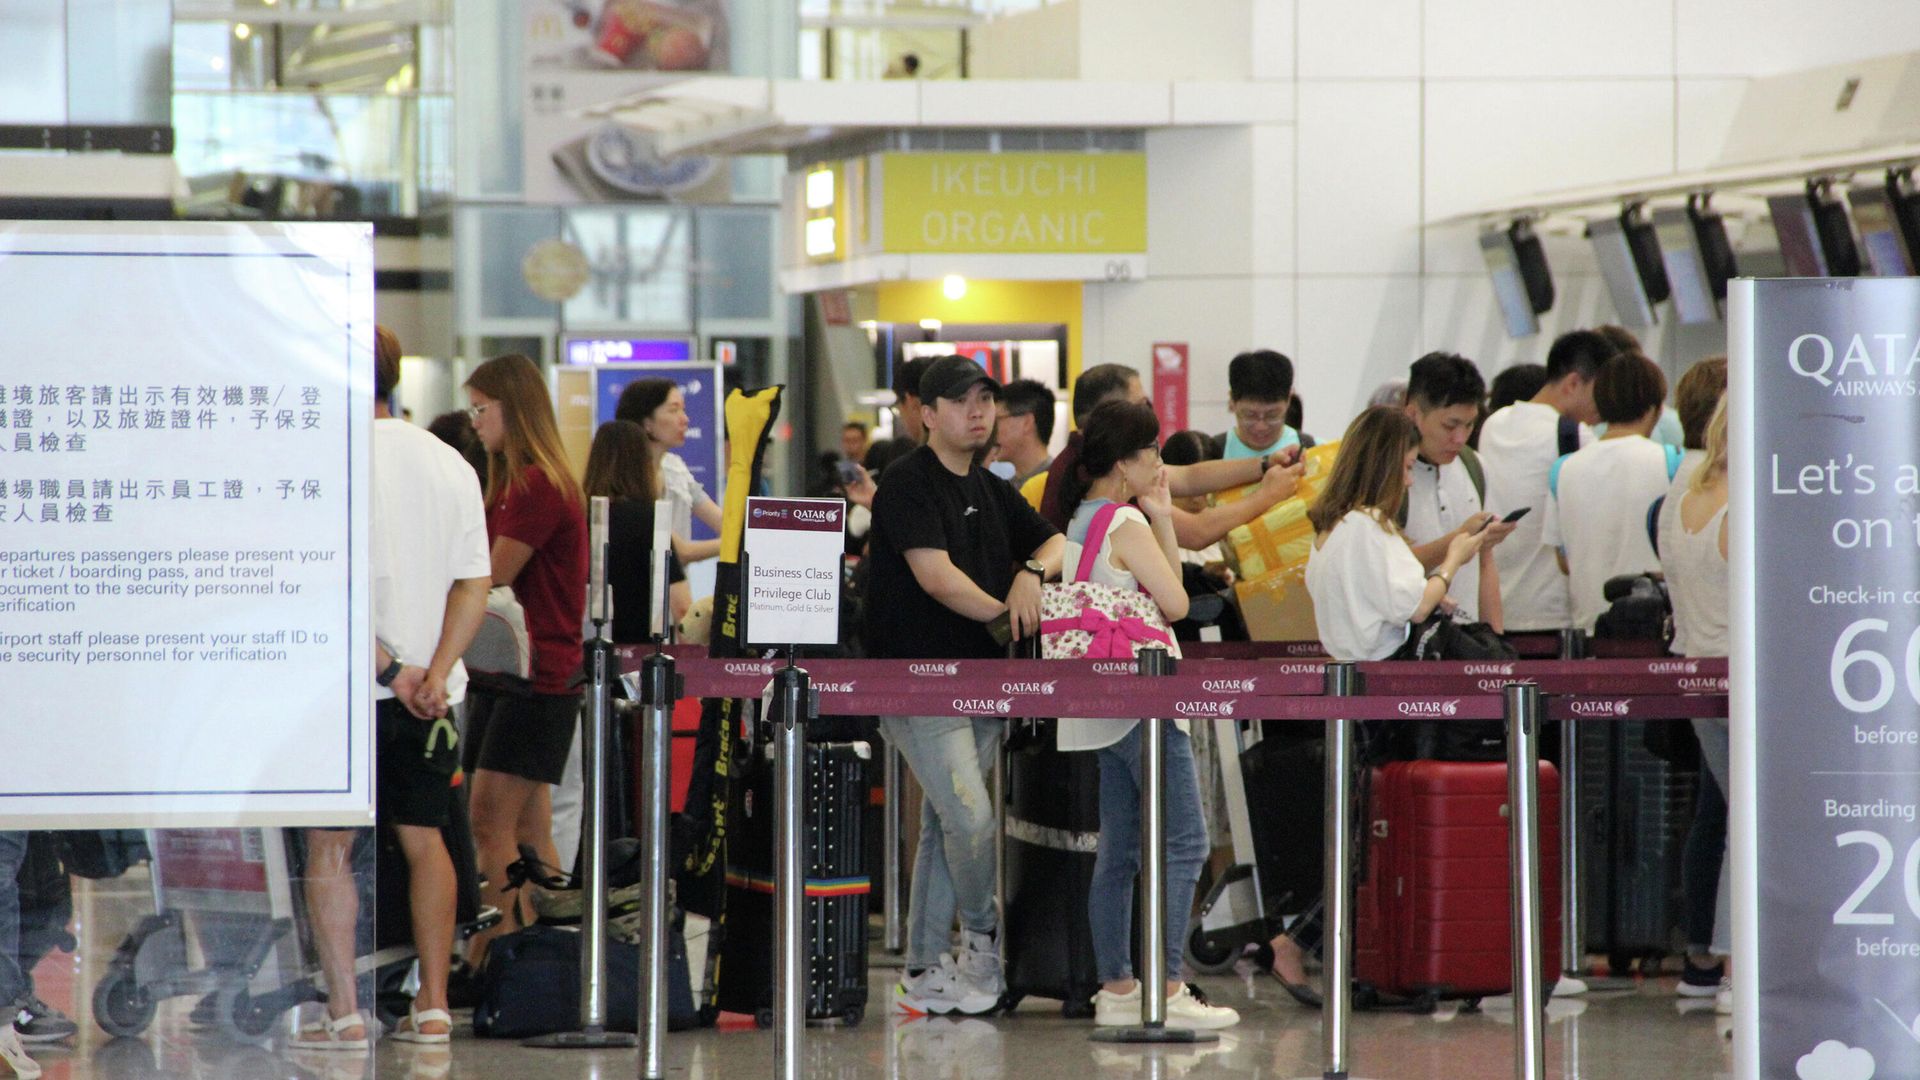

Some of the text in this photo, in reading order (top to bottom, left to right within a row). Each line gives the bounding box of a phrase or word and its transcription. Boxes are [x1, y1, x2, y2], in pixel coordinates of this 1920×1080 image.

[931, 161, 1097, 197] IKEUCHI
[922, 209, 1105, 246] ORGANIC
[1833, 380, 1915, 397] AIRWAYS
[1772, 453, 1876, 495] Let's
[793, 509, 825, 520] QATAR
[1832, 517, 1892, 549] on
[81, 549, 172, 565] passengers
[178, 548, 229, 564] please
[235, 549, 294, 565] present
[300, 550, 336, 564] your
[13, 564, 54, 578] ticket
[59, 565, 65, 578] /
[70, 564, 142, 582] boarding
[148, 566, 189, 582] pass,
[194, 564, 224, 578] and
[230, 564, 274, 578] travel
[754, 566, 833, 580] Business Class
[75, 583, 90, 595] to
[96, 581, 121, 595] the
[127, 581, 189, 599] security
[194, 581, 274, 599] personnel
[280, 581, 302, 595] for
[754, 587, 832, 602] Privilege Club
[1809, 585, 1895, 604] Check-in
[749, 602, 833, 613] Platinum, Gold & Silver
[48, 630, 83, 646] staff
[88, 631, 139, 648] please
[145, 633, 204, 649] present
[210, 633, 245, 649] your
[251, 630, 285, 645] staff
[291, 630, 308, 644] ID
[313, 631, 329, 645] to
[18, 646, 80, 664] security
[86, 646, 166, 664] personnel
[172, 647, 193, 661] for
[200, 646, 287, 661] verification
[725, 663, 760, 673] QATAR
[909, 663, 945, 674] QATAR
[1092, 662, 1128, 673] QATAR
[1280, 664, 1316, 674] QATAR
[1464, 665, 1499, 675] QATAR
[1649, 663, 1684, 673] QATAR
[1830, 618, 1920, 713] 6
[811, 682, 839, 692] ATAR
[1001, 682, 1040, 693] QATAR
[1202, 680, 1241, 691] QATAR
[1678, 678, 1716, 689] QATAR
[952, 699, 995, 712] QATAR
[1175, 701, 1218, 713] QATAR
[1398, 701, 1441, 713] QATAR
[1571, 701, 1613, 713] QATAR
[1854, 725, 1918, 744] before
[1825, 799, 1916, 822] Boarding
[1833, 830, 1920, 925] 2
[1856, 938, 1920, 957] before
